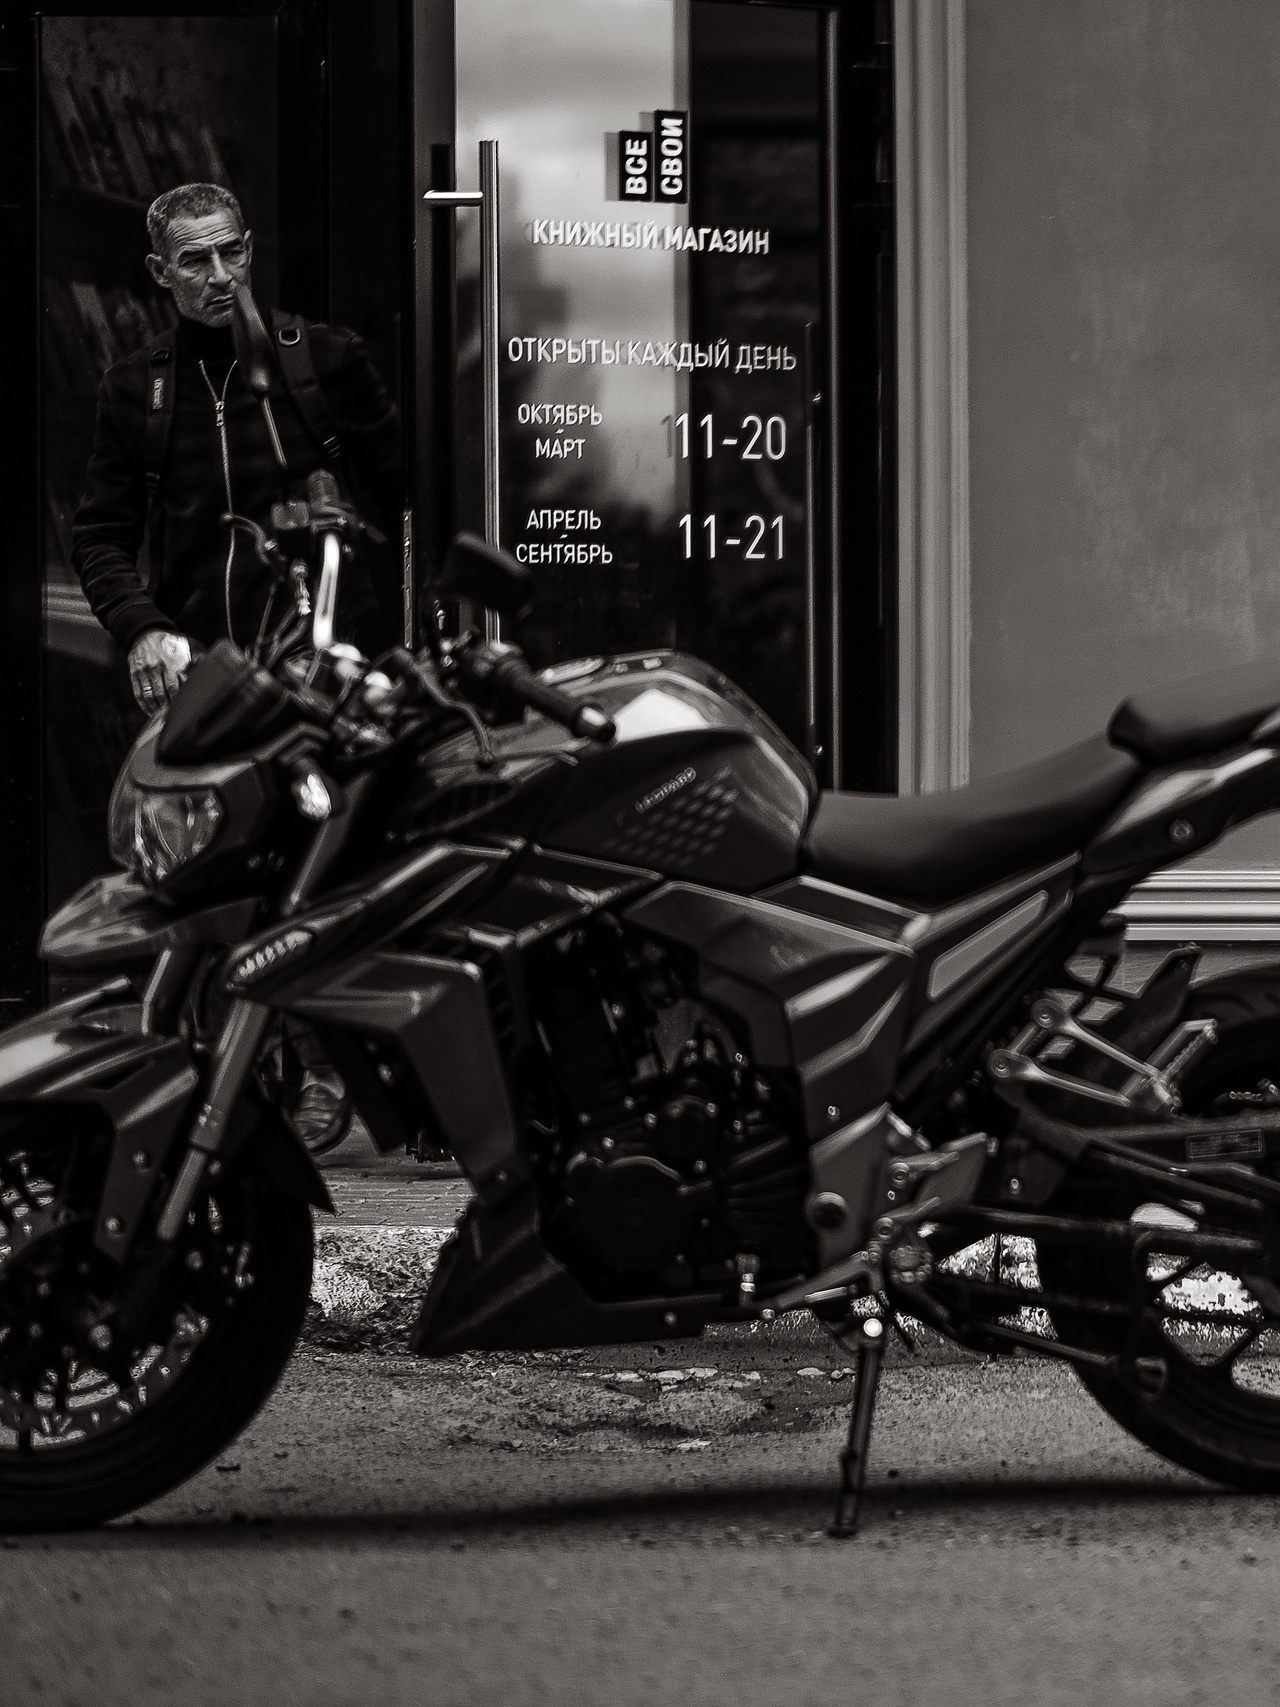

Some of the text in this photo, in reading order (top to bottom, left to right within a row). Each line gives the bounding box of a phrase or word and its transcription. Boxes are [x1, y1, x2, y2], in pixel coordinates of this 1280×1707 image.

[625, 138, 648, 195] ВСЕ
[660, 117, 684, 196] СВОИ
[532, 219, 770, 254] КНИЖНЫЙ МАГАЗИН
[508, 336, 798, 374] ОТКРЫТЫ КАЖДЫЙ ДЕНЬ
[517, 403, 603, 426] ОКТЯБРЬ
[535, 438, 585, 459] МАРТ
[674, 412, 787, 461] 11-20
[525, 509, 601, 531] АПРЕЛЬ
[678, 513, 785, 560] 11-21
[516, 543, 613, 564] СЕНТЯБРЬ
